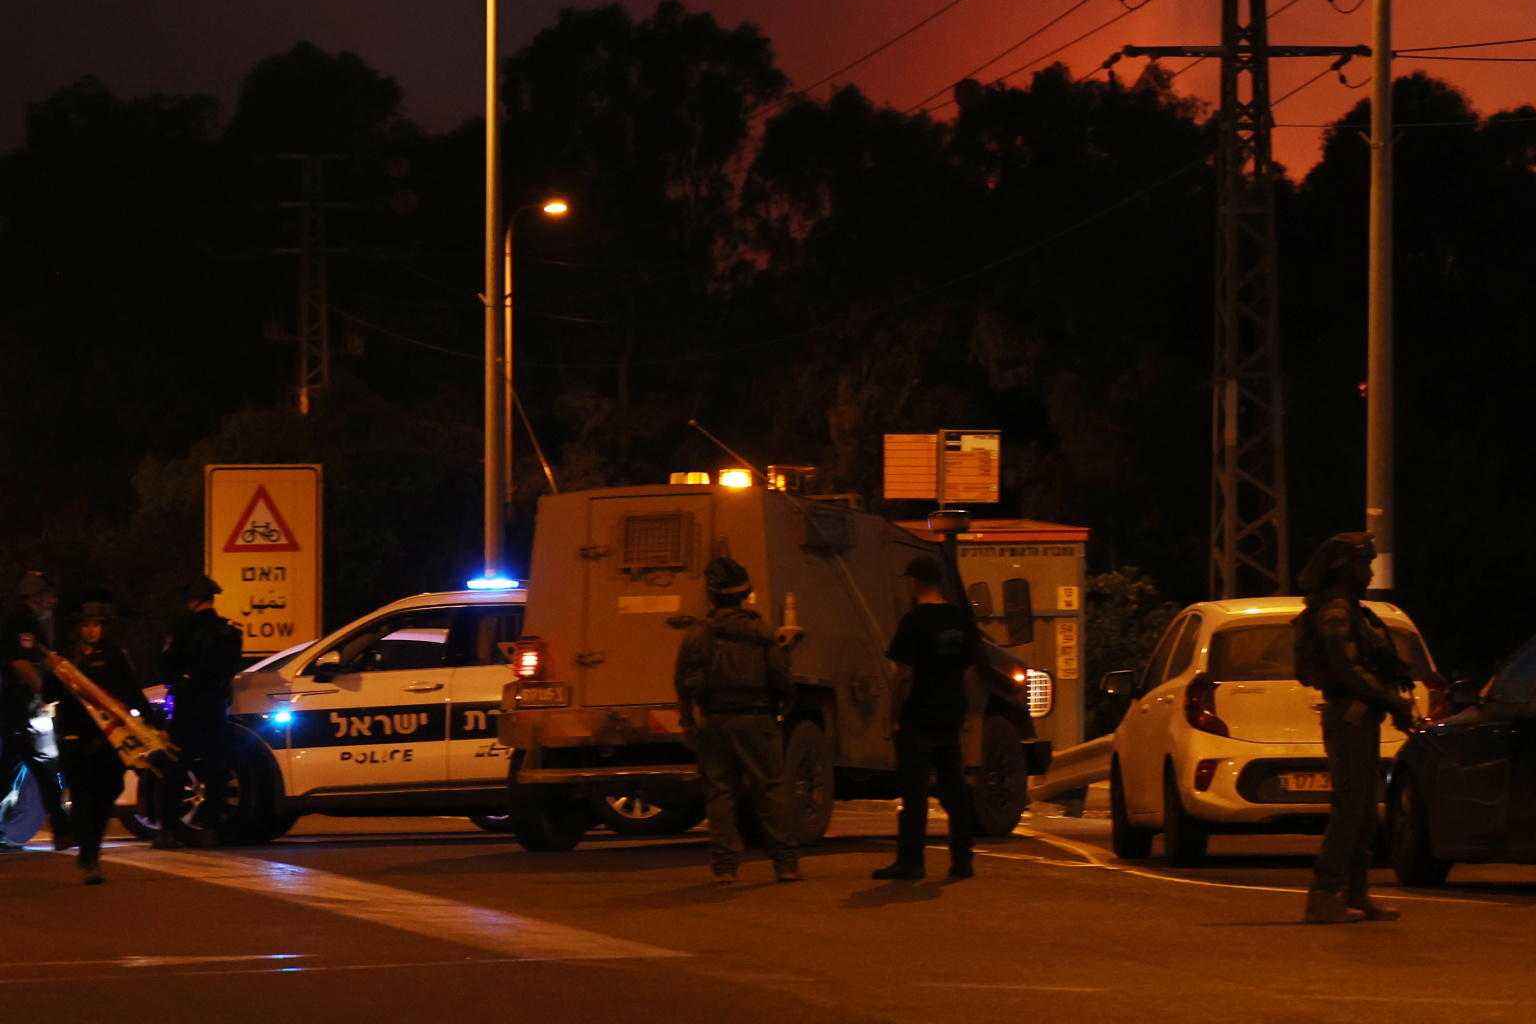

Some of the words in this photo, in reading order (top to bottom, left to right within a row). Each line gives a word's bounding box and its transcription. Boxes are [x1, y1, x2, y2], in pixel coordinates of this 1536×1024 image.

[241, 622, 296, 638] LOW
[330, 711, 429, 738] ישראל
[339, 748, 414, 764] POLICE
